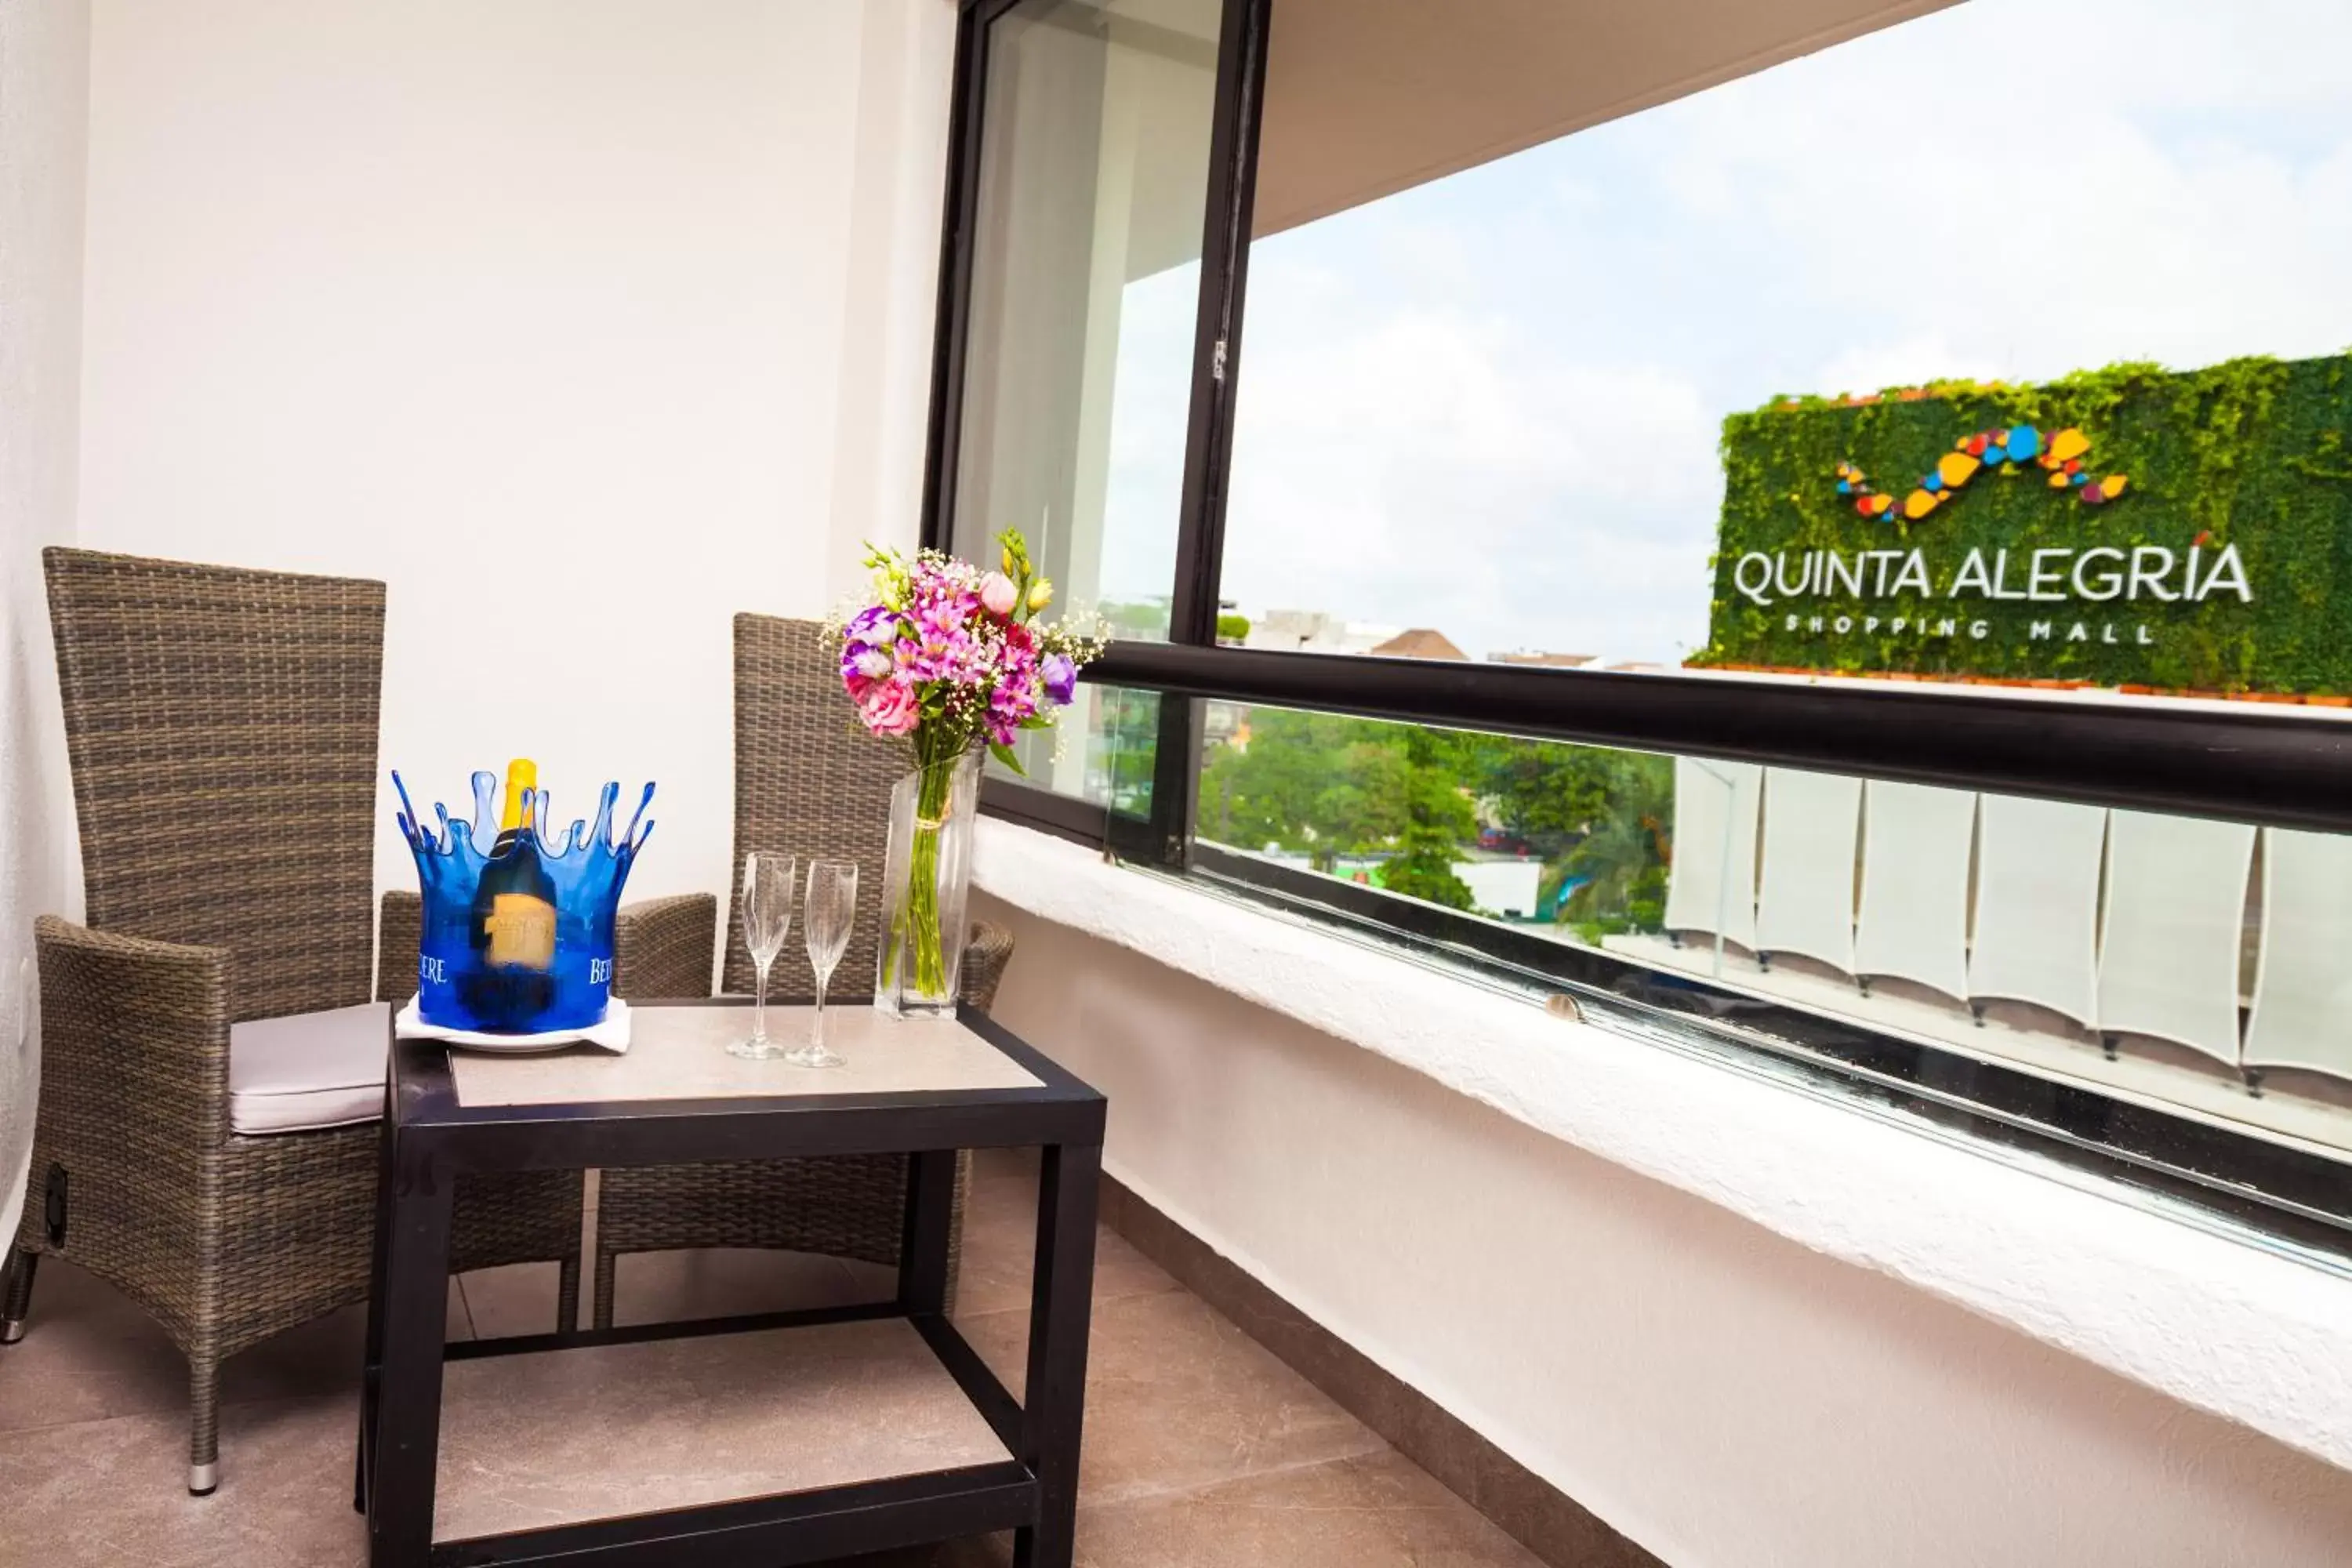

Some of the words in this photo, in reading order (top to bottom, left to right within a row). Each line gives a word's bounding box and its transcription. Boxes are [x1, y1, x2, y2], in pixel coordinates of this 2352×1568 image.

[1733, 546, 1932, 606] QUINTA
[1947, 529, 2255, 603] ALEGRÍA
[1784, 613, 1988, 640] SHOPPING
[2028, 619, 2154, 645] MALL
[419, 953, 448, 985] ERE
